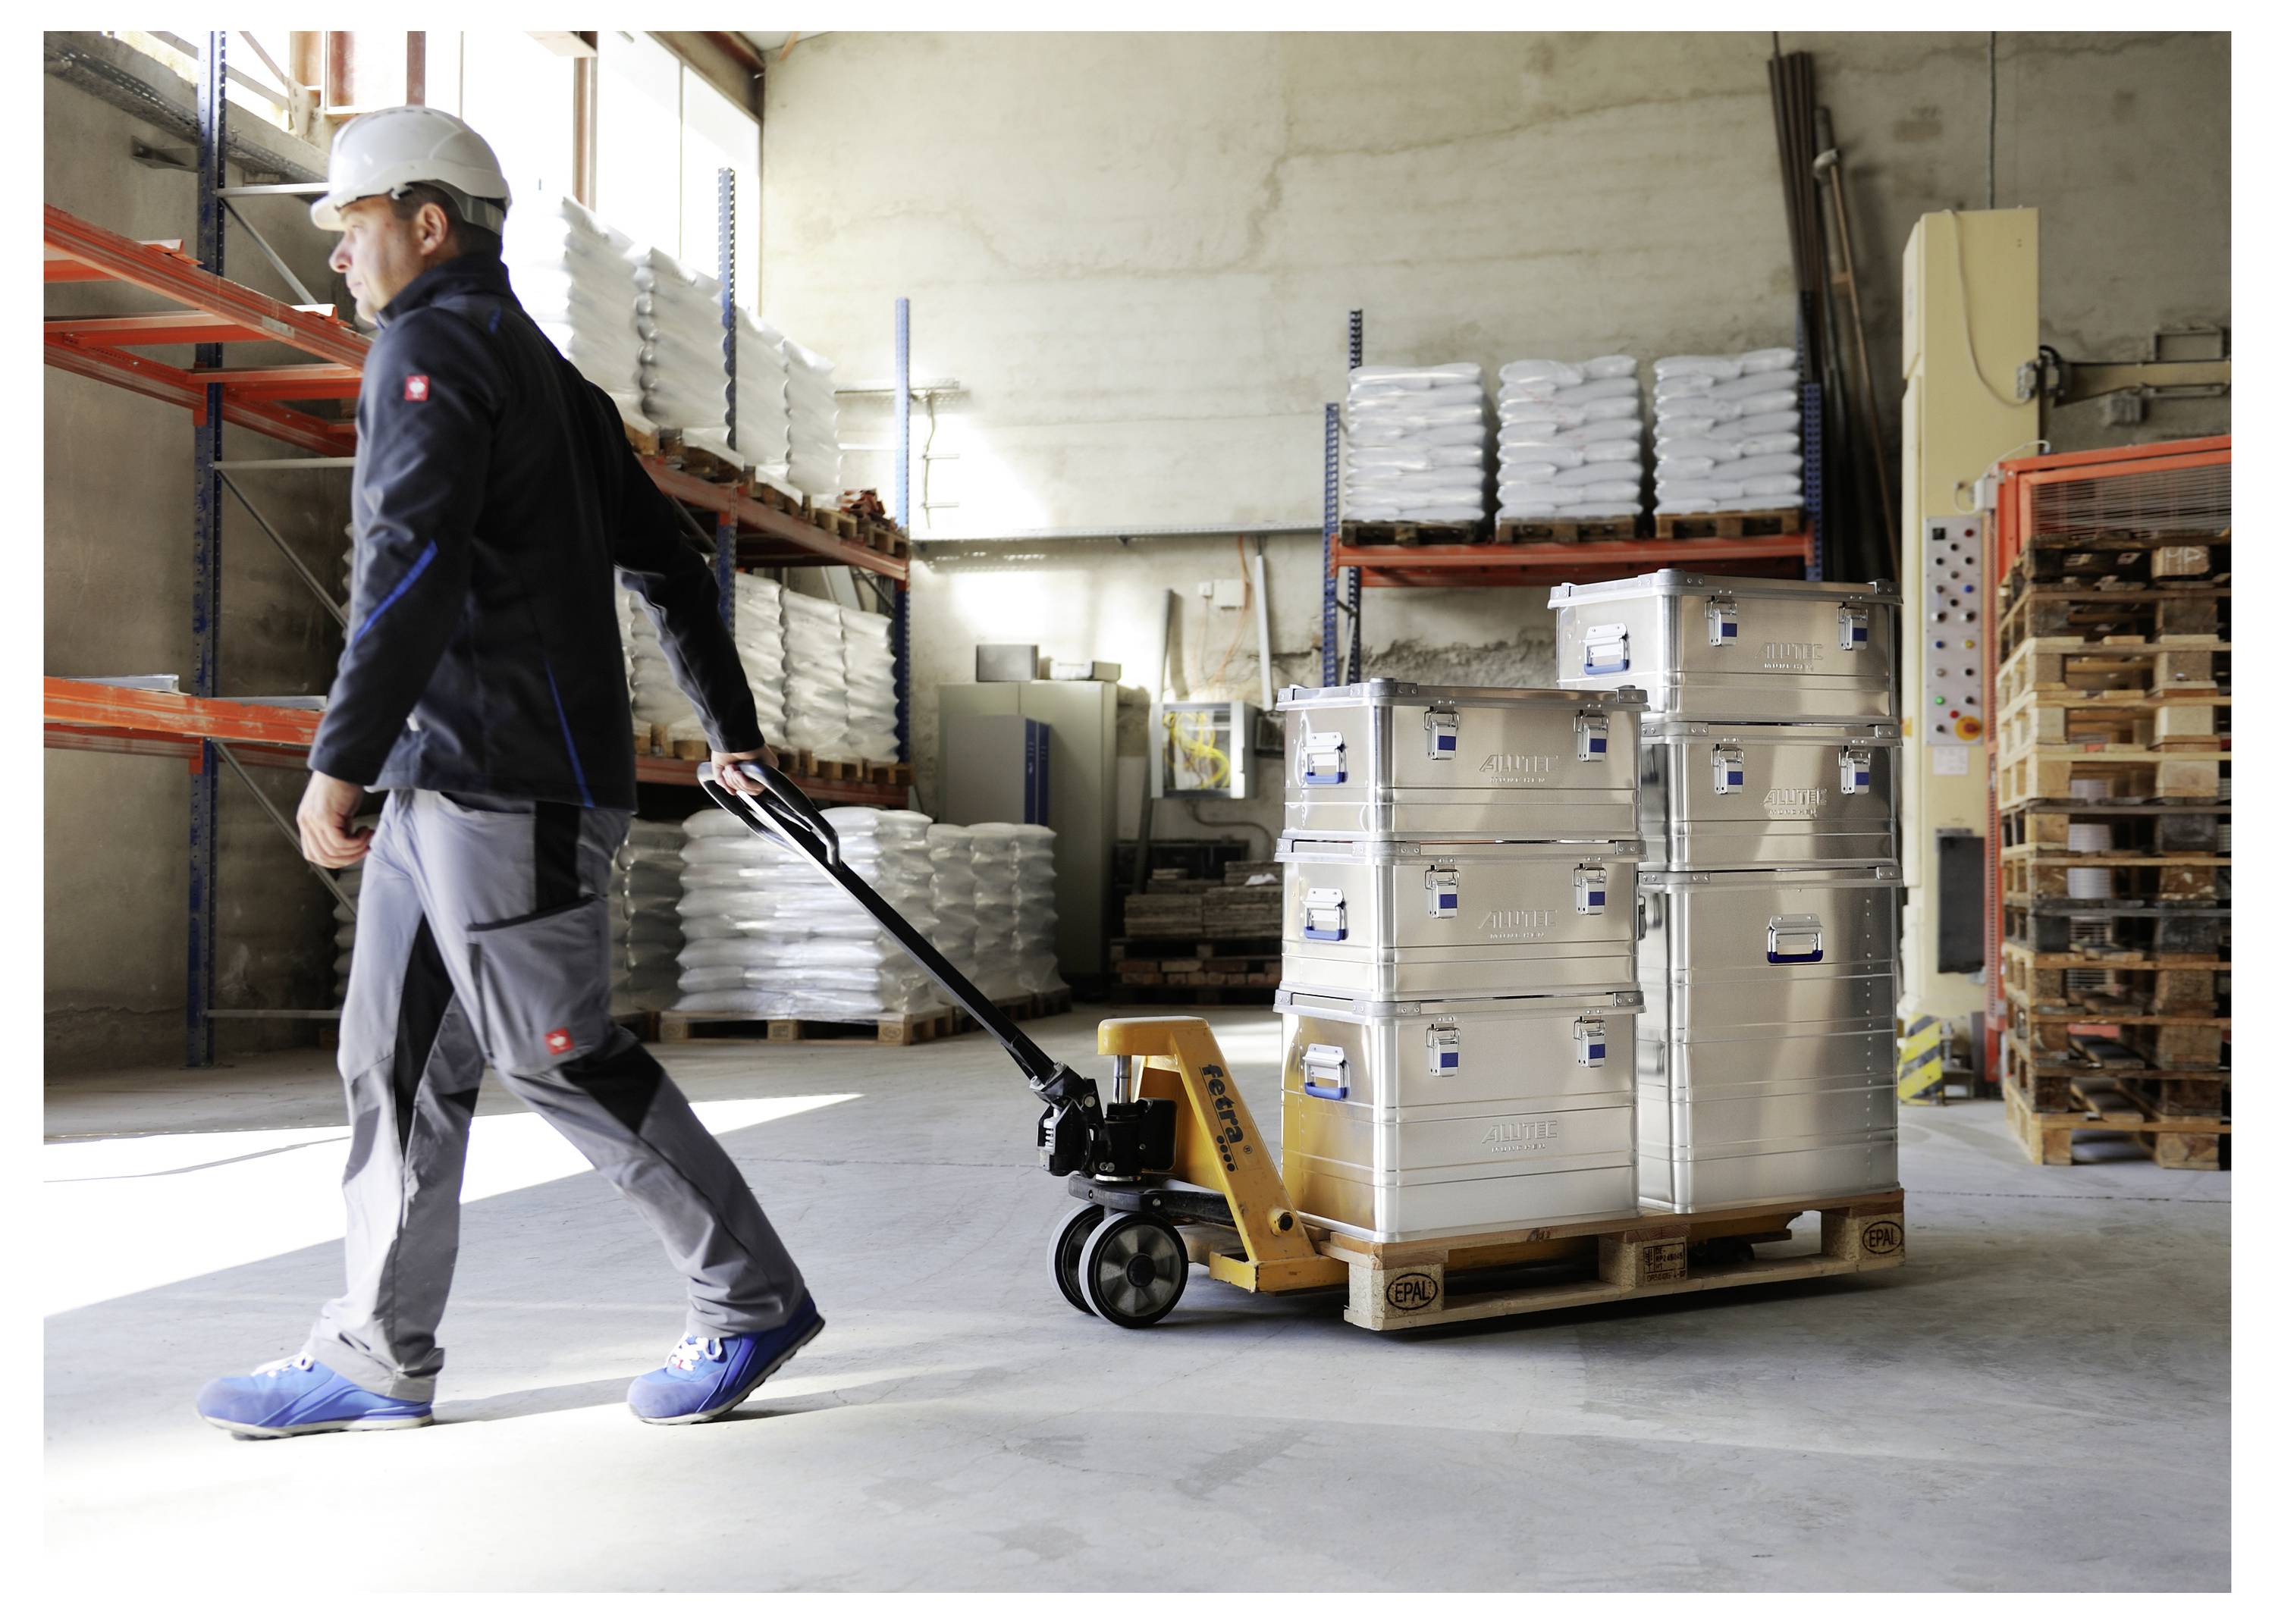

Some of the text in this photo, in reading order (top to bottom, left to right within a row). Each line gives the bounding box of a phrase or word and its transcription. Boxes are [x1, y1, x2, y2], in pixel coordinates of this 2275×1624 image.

[1754, 642, 1823, 660] ALUTEC
[1479, 754, 1558, 773] ALUTEC
[1761, 788, 1827, 805] ALUTEC
[1478, 910, 1558, 929] ALUTEC
[1202, 1064, 1244, 1144] fetra
[1481, 1121, 1558, 1144] ALUTEC
[1869, 1228, 1897, 1248] EPAL
[1395, 1281, 1430, 1303] EPAL
